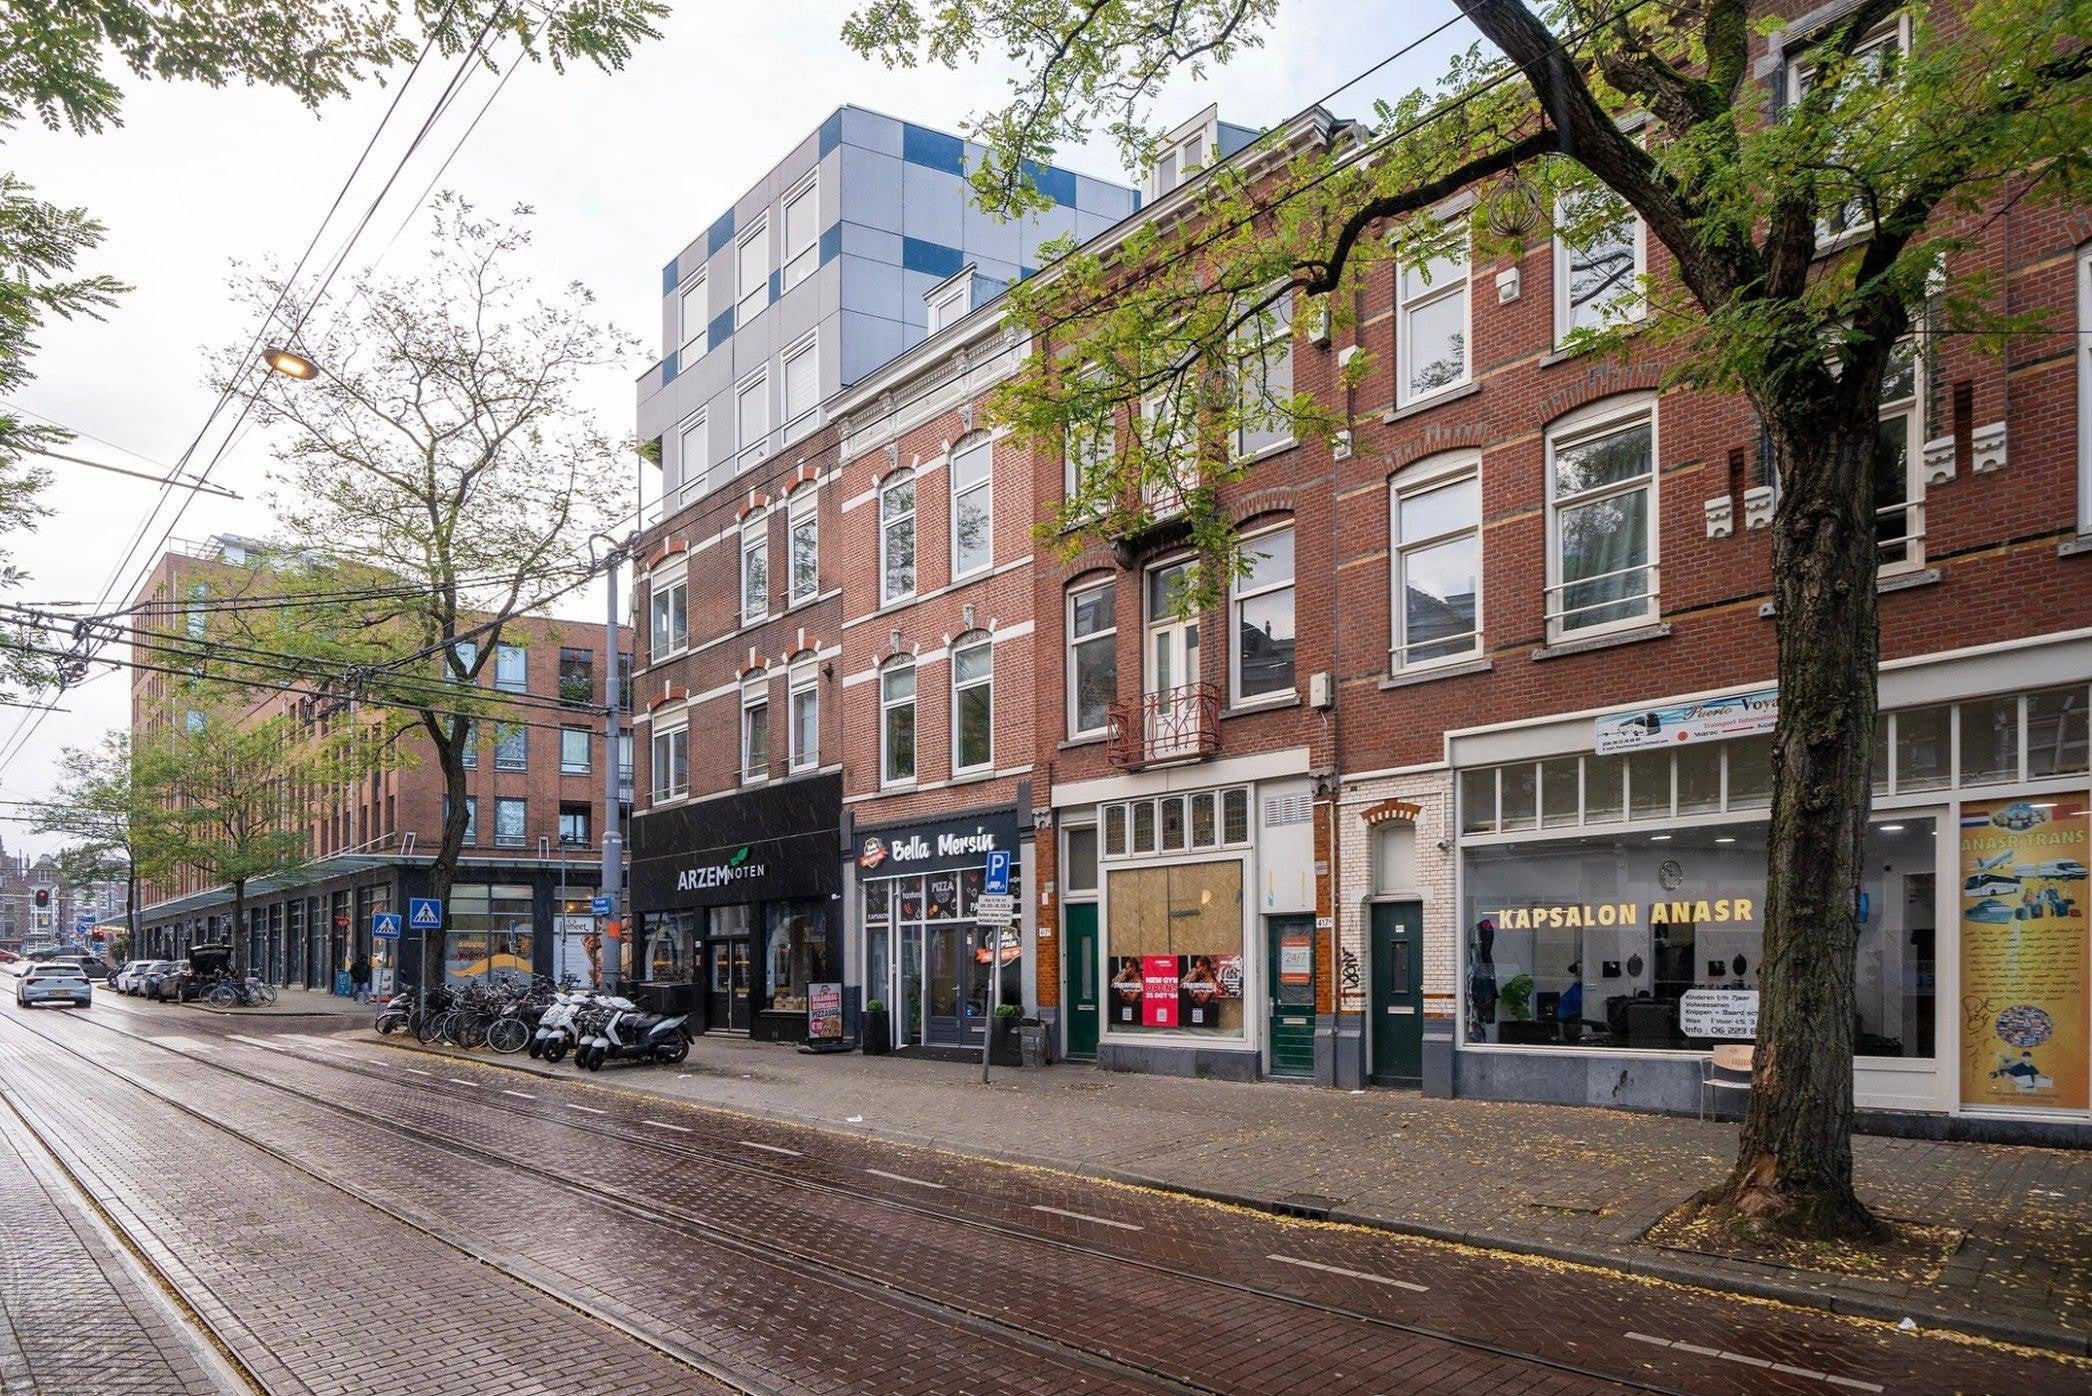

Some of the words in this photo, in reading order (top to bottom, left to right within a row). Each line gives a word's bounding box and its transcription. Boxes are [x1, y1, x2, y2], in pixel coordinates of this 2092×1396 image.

[1683, 704, 1733, 721] Puerto
[1703, 718, 1737, 729] Transport
[891, 835, 930, 862] Bella
[937, 826, 995, 857] Mersin
[1961, 834, 2017, 852] ANASR
[2026, 829, 2085, 847] TRANS
[991, 854, 1005, 876] P
[677, 864, 728, 891] ARZEM
[728, 864, 765, 880] NOTEN
[931, 880, 955, 892] PIZZA
[1499, 904, 1638, 930] KAPSALON
[1651, 899, 1753, 925] ANASR
[1711, 1026, 1725, 1035] 06
